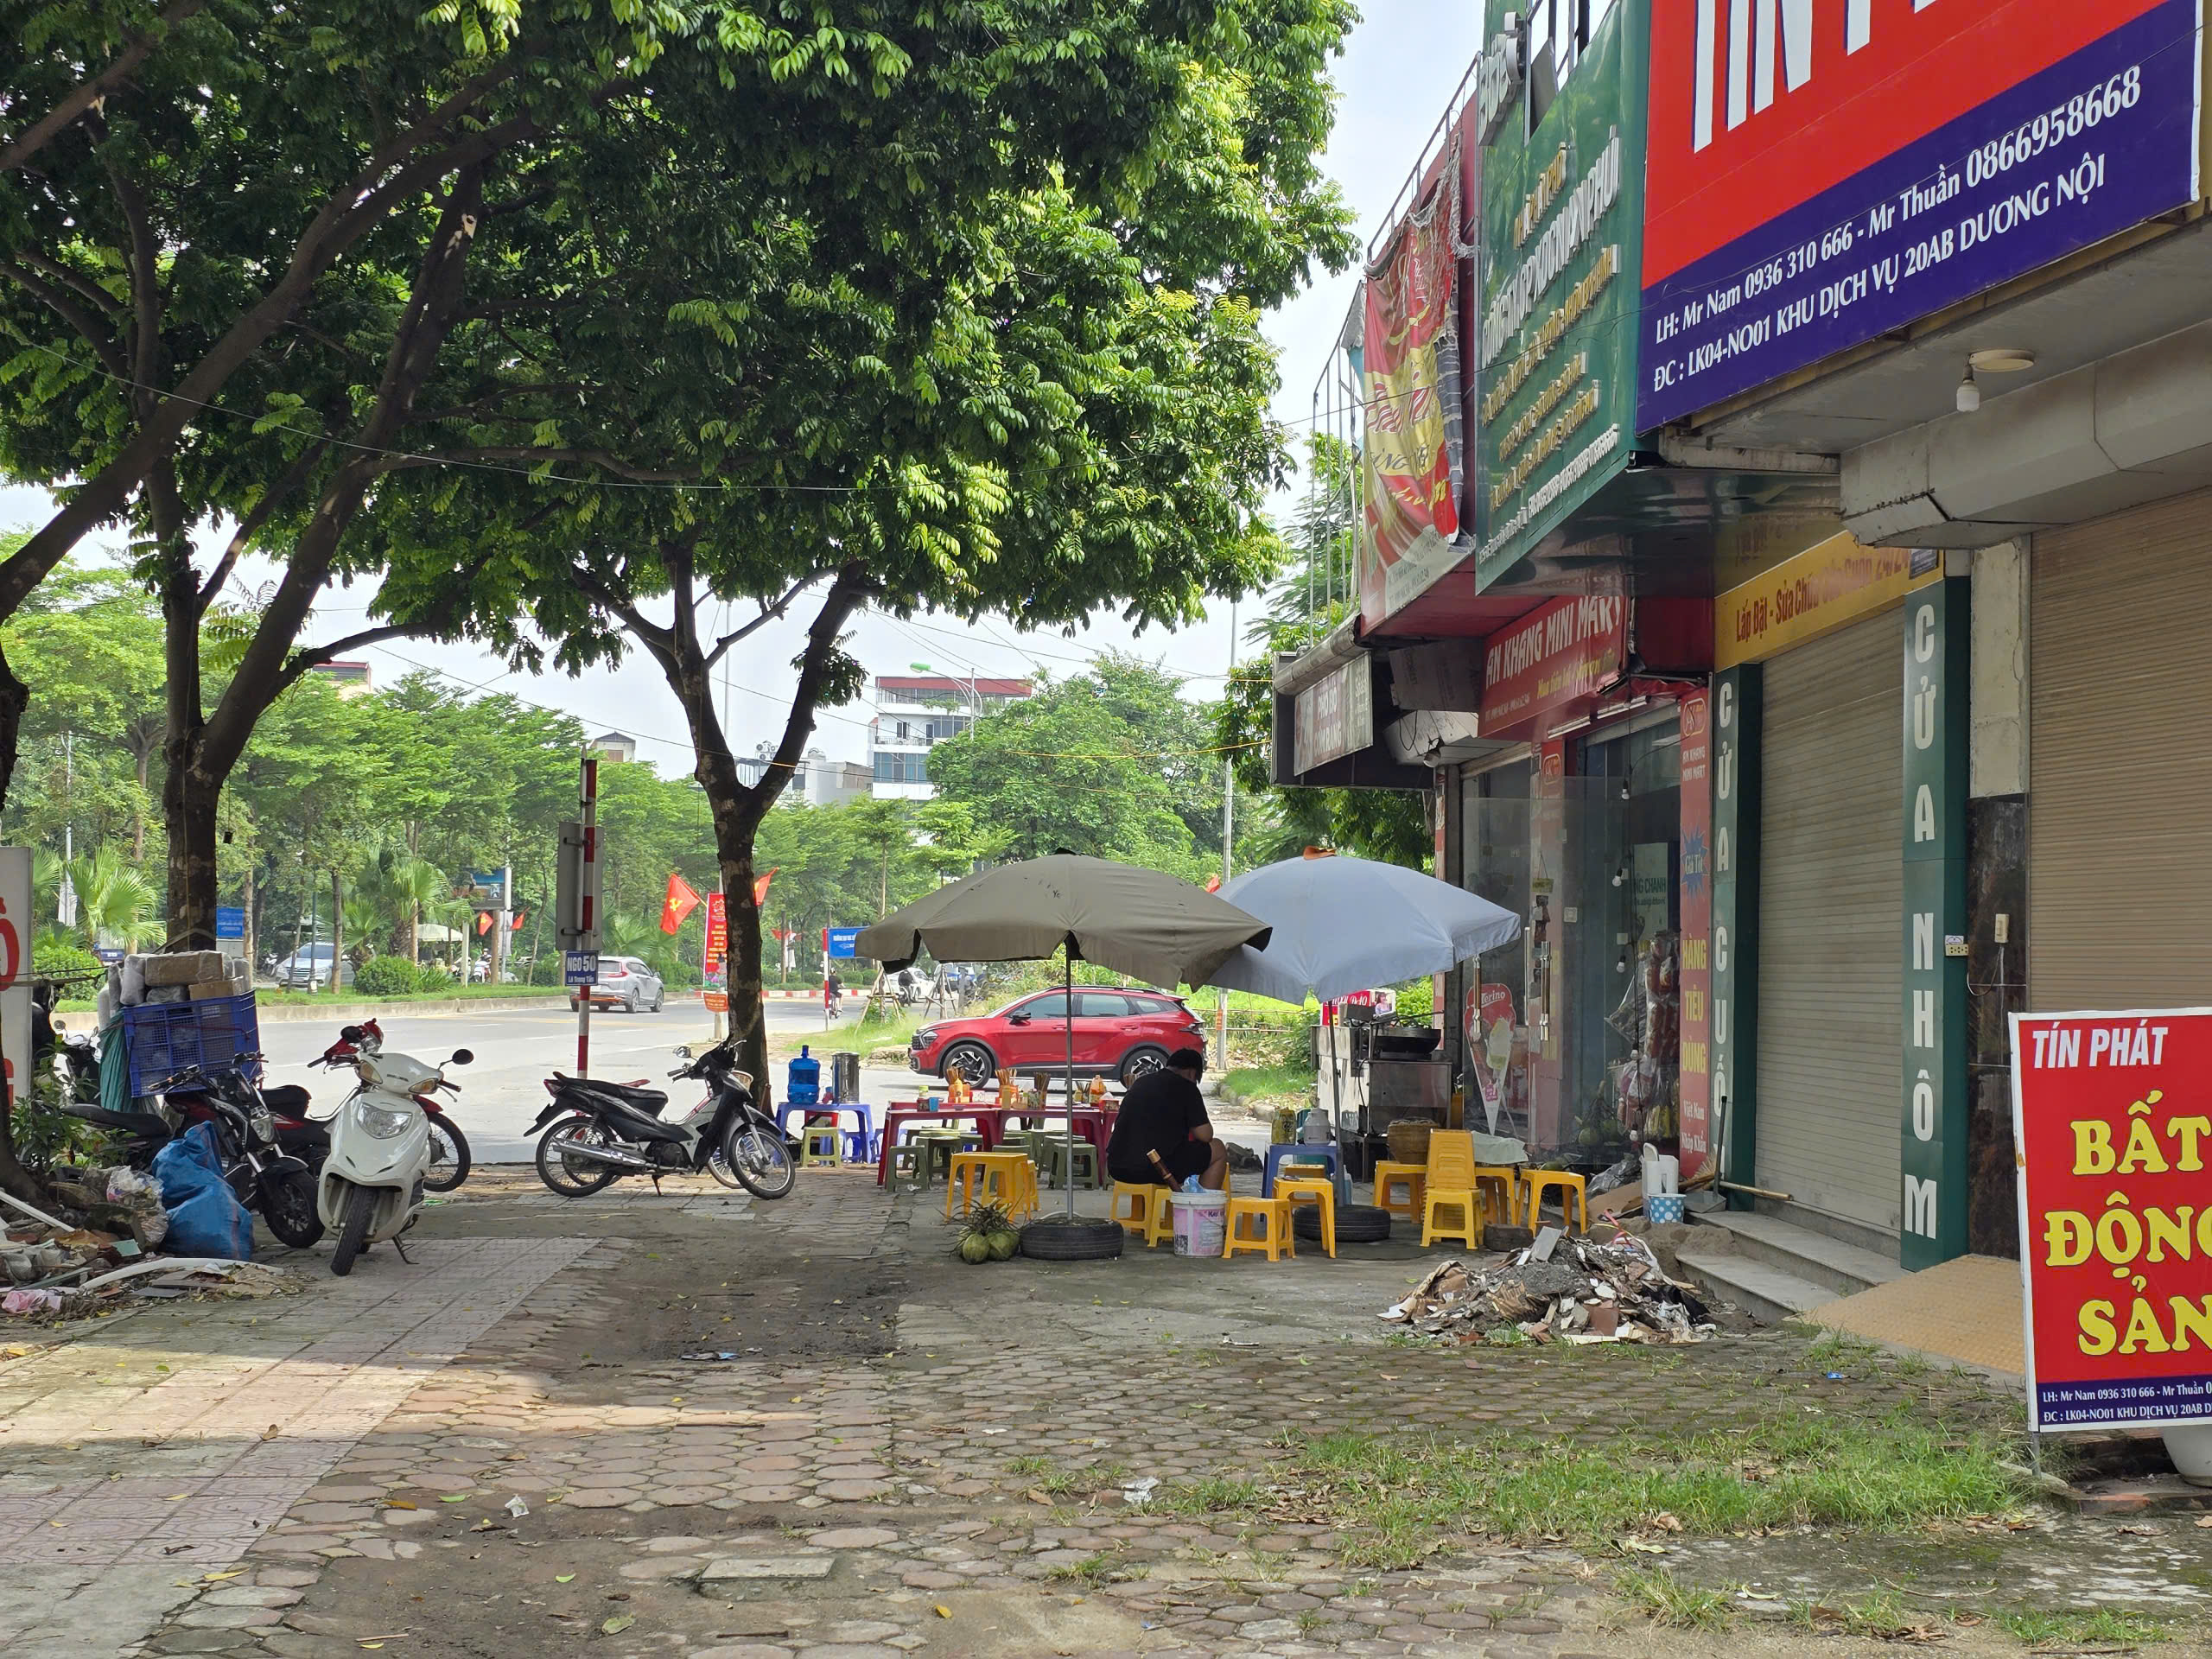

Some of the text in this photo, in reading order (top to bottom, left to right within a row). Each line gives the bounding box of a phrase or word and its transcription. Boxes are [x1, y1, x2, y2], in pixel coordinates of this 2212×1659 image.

[1656, 315, 1679, 345] LH:
[1682, 300, 1705, 332] Mr
[1707, 283, 1741, 318] Nam
[1744, 262, 1783, 301] 0936
[1786, 240, 1816, 276] 310
[1821, 222, 1853, 262] 666
[1868, 204, 1895, 239] Mr
[1900, 164, 1961, 222] Thuần
[1966, 65, 2141, 188] 0866958668
[1688, 315, 1771, 378] LK04-NO01
[1776, 294, 1815, 334] KHU
[1819, 270, 1867, 324] DỊCH
[1872, 259, 1899, 296] VỤ
[1904, 232, 1955, 278] 20AB
[1959, 181, 2050, 252] DƯƠNG
[2056, 152, 2106, 207] NỘI
[1752, 596, 1768, 639] Đặt
[1776, 580, 1794, 625] Sửa
[1486, 643, 1502, 690] AN
[1503, 620, 1543, 680] KHANG
[1545, 601, 1574, 658] MINI
[582, 955, 596, 972] 50
[1682, 933, 1707, 970] HÀNG
[1682, 1036, 1707, 1074] DÙNG
[2032, 1019, 2169, 1069] TÍN PHÁT
[1693, 1105, 1705, 1122] Nam
[2070, 1090, 2211, 1176] BẤT
[2077, 1274, 2212, 1357] SẢN
[2043, 1391, 2058, 1402] LH:
[2060, 1390, 2074, 1402] Mr
[2075, 1389, 2095, 1401] Nam
[2097, 1389, 2119, 1400] 0936
[2120, 1388, 2137, 1399] 310
[2139, 1386, 2155, 1397] 666
[2162, 1385, 2175, 1396] Mr
[2176, 1381, 2203, 1396] Thuần
[2065, 1408, 2114, 1421] LK04-NO01
[2117, 1407, 2138, 1419] KHU
[2139, 1405, 2164, 1420] DỊCH
[2164, 1404, 2178, 1418] VỤ
[2180, 1403, 2202, 1415] 20AB
